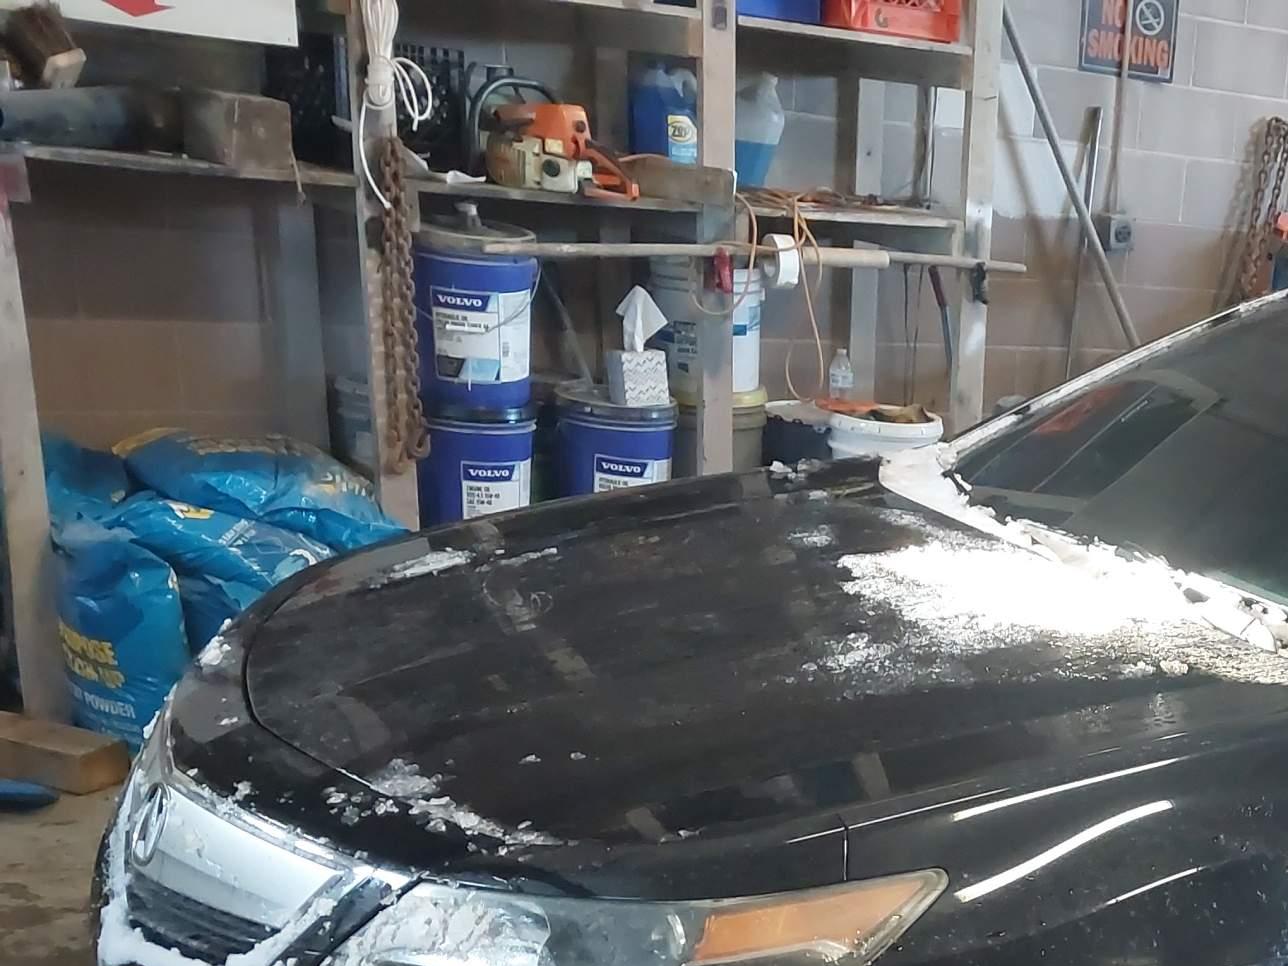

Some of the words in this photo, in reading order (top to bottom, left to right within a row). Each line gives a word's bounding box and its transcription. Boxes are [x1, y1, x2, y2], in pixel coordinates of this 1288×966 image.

[1087, 28, 1170, 72] SMOKING
[436, 294, 483, 308] VOLVO
[467, 468, 510, 478] VOLVO
[600, 461, 642, 474] VOLVO
[84, 690, 137, 719] POWDER
